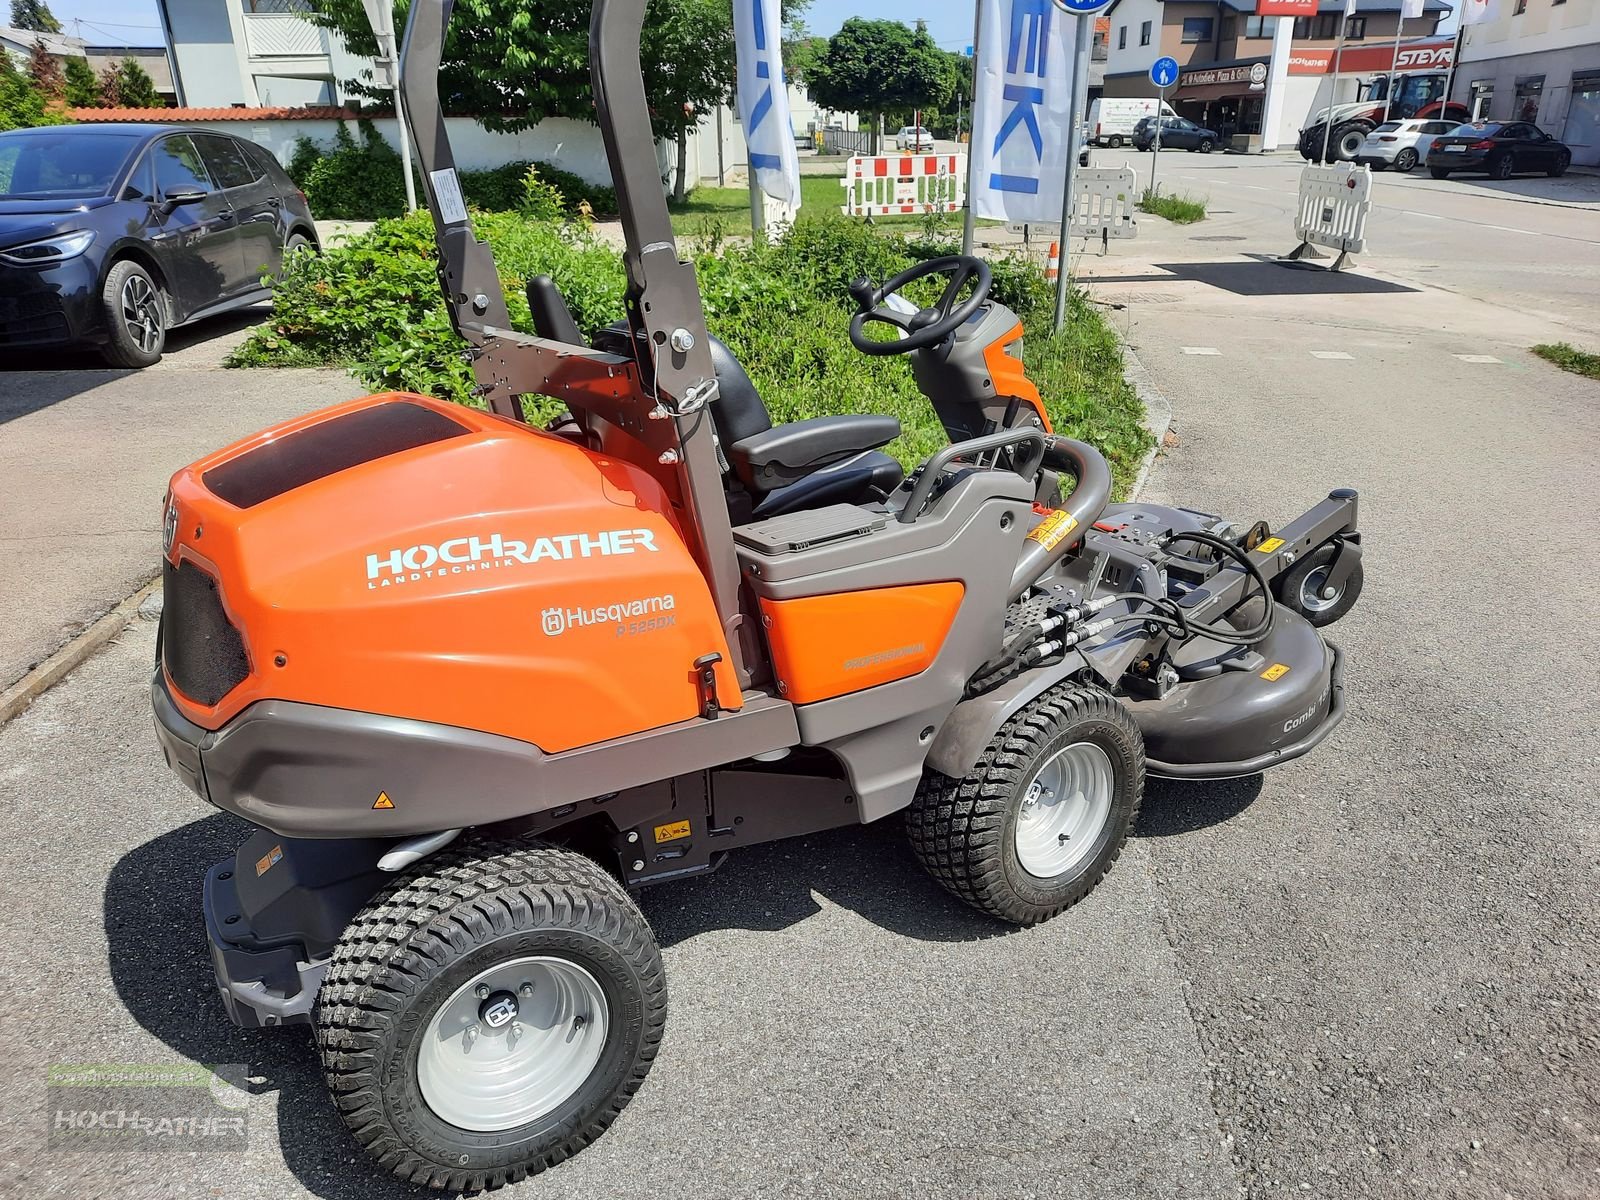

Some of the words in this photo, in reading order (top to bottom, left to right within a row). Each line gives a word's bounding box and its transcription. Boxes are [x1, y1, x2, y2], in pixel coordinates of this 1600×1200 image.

[1289, 57, 1329, 67] OCHRATHER
[1396, 47, 1453, 66] STEYR
[366, 528, 659, 580] HOCHRATHER
[368, 558, 514, 590] LANDTECHNIK
[566, 594, 675, 628] Husqvarna
[616, 625, 626, 637] P
[629, 615, 676, 635] 525DX
[1283, 702, 1316, 733] Combi
[1095, 725, 1133, 768] COMMERCIAL
